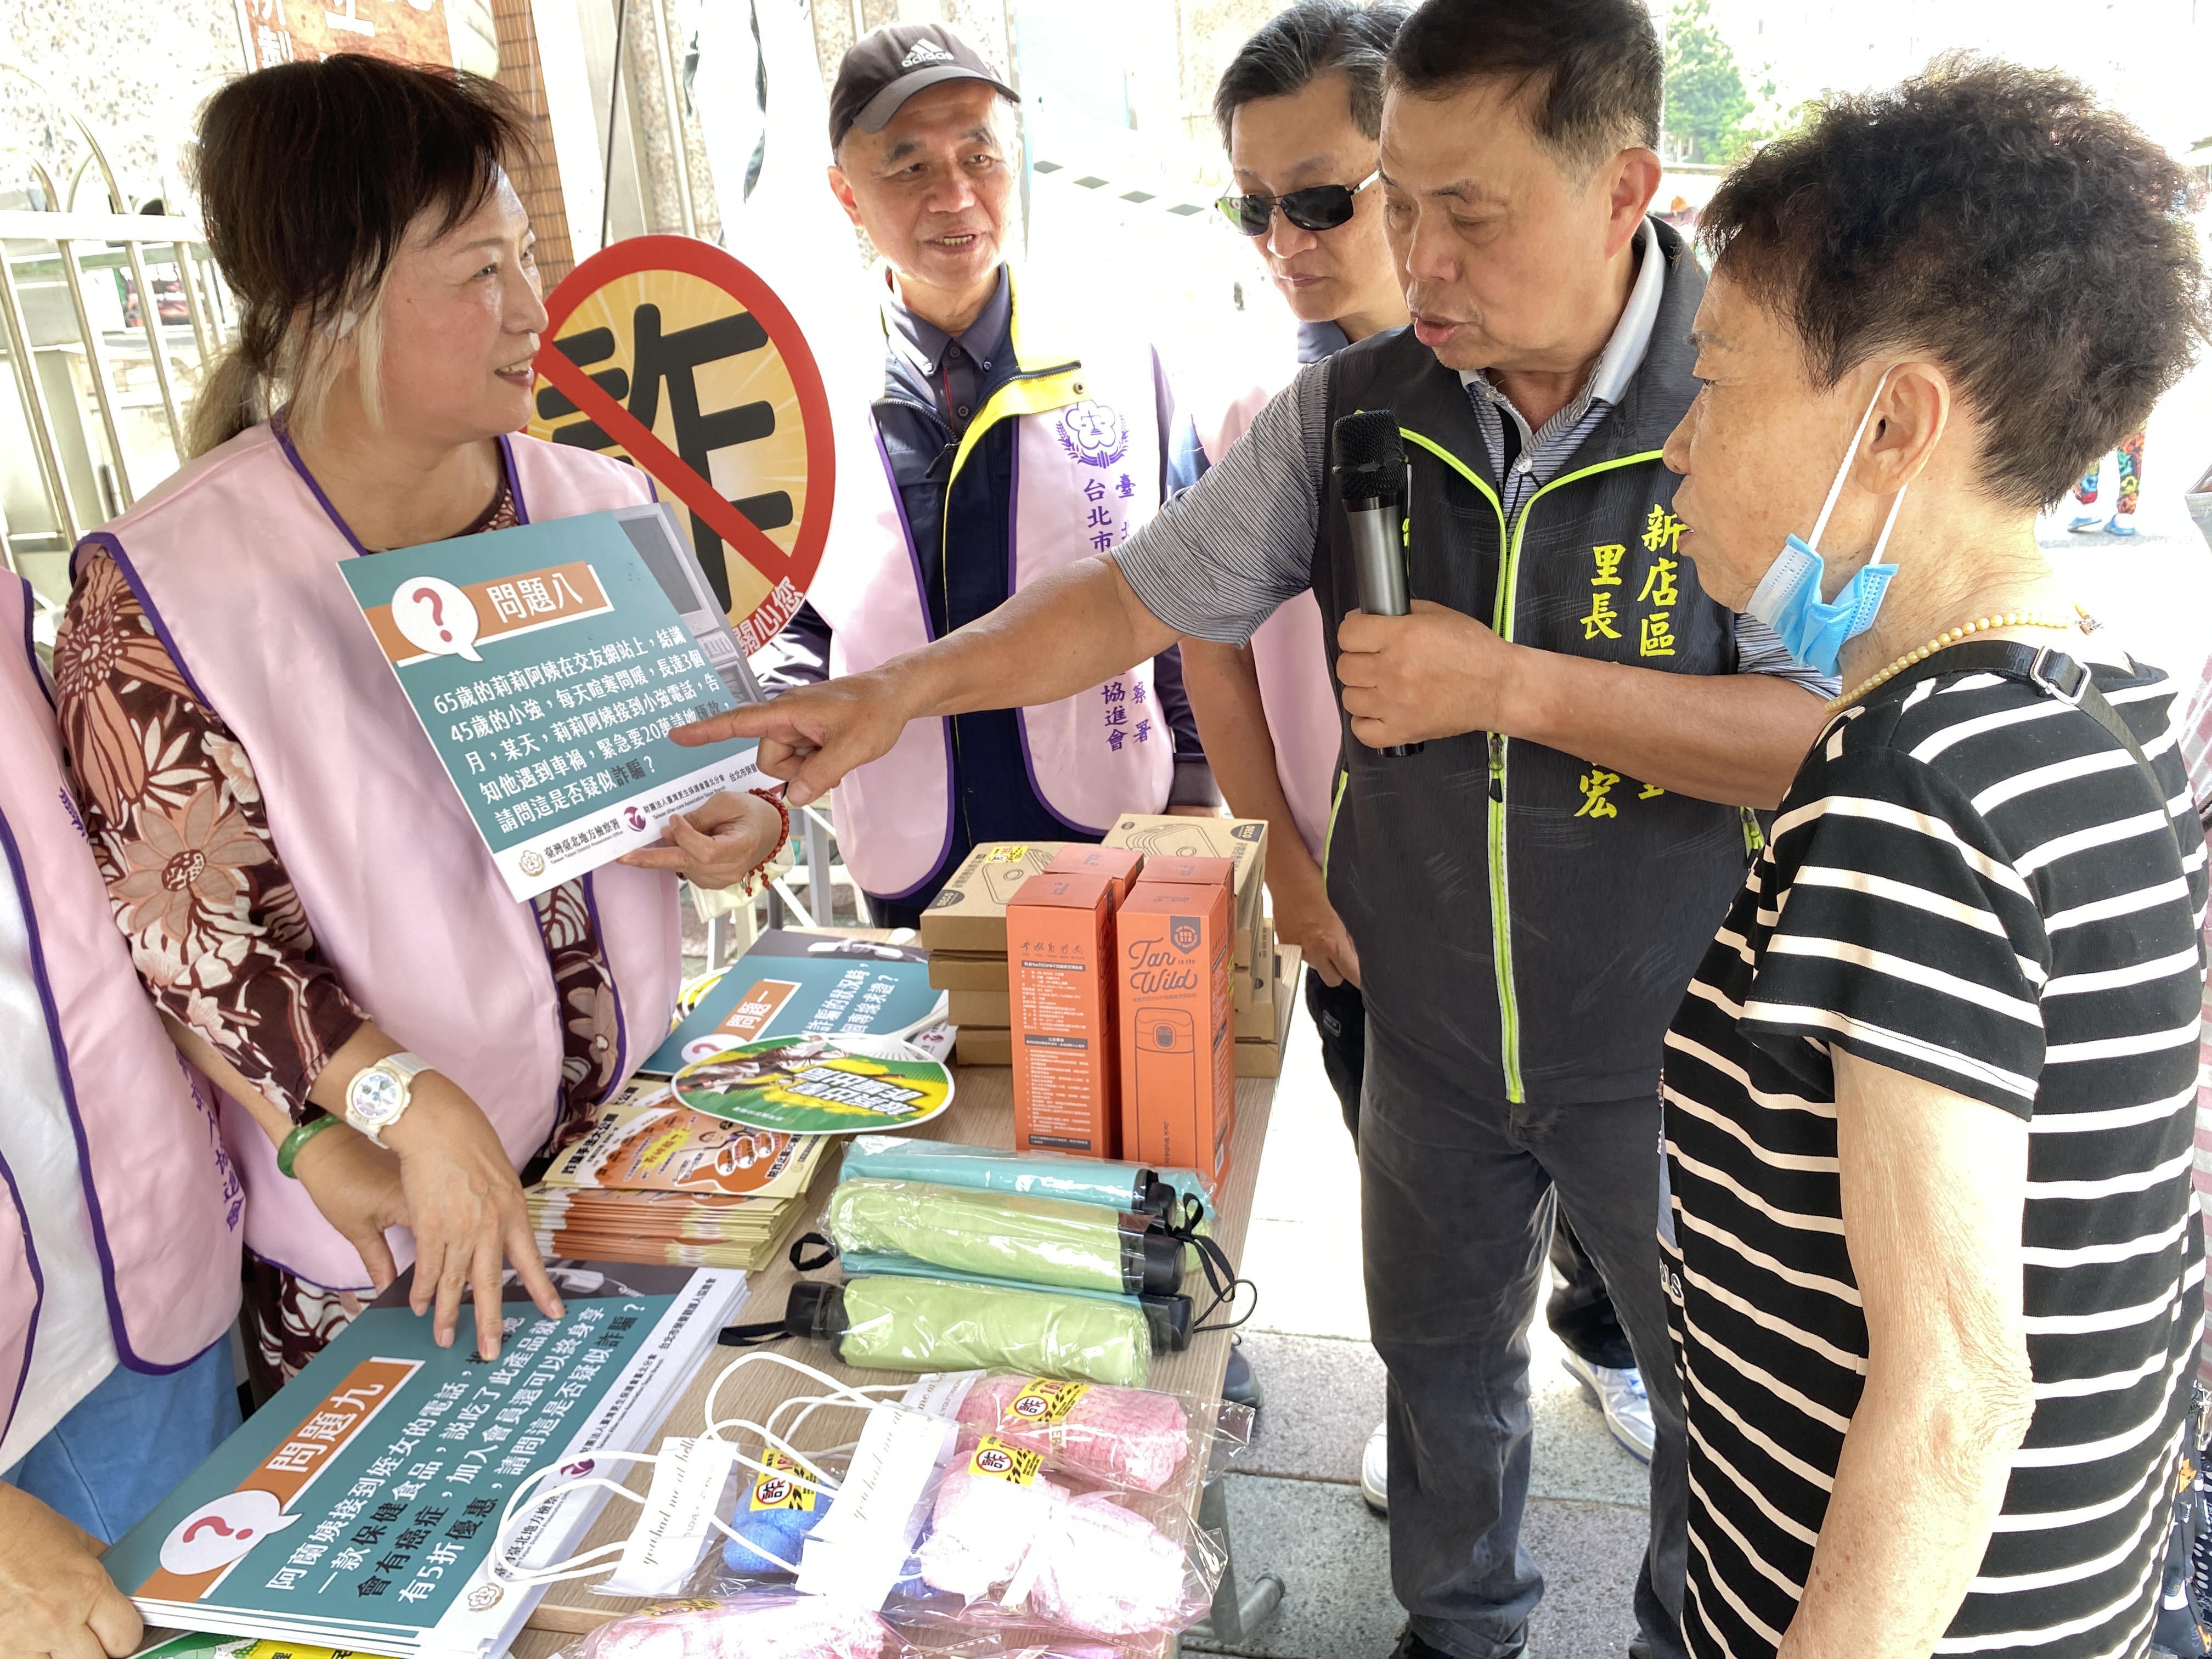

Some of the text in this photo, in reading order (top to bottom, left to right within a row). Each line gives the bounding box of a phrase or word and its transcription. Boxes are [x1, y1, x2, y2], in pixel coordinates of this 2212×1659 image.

[1084, 478, 1113, 552] 台北市
[487, 572, 583, 624] 問題八
[732, 576, 806, 657] 關心您
[1580, 544, 1626, 640] 里長
[1637, 504, 1688, 657] 新店區
[1101, 681, 1128, 752] 協進會
[494, 756, 655, 834] 請問這是否疑似詐騙？
[1573, 770, 1620, 819] 宏
[1128, 937, 1176, 970] Tan
[1130, 969, 1198, 994] Wild
[802, 963, 871, 1034] 詐騙的狀況時，
[266, 1383, 385, 1473] 問題九
[318, 1311, 565, 1594] 一款保健食品，說吃了此產品就
[649, 1510, 671, 1537] had
